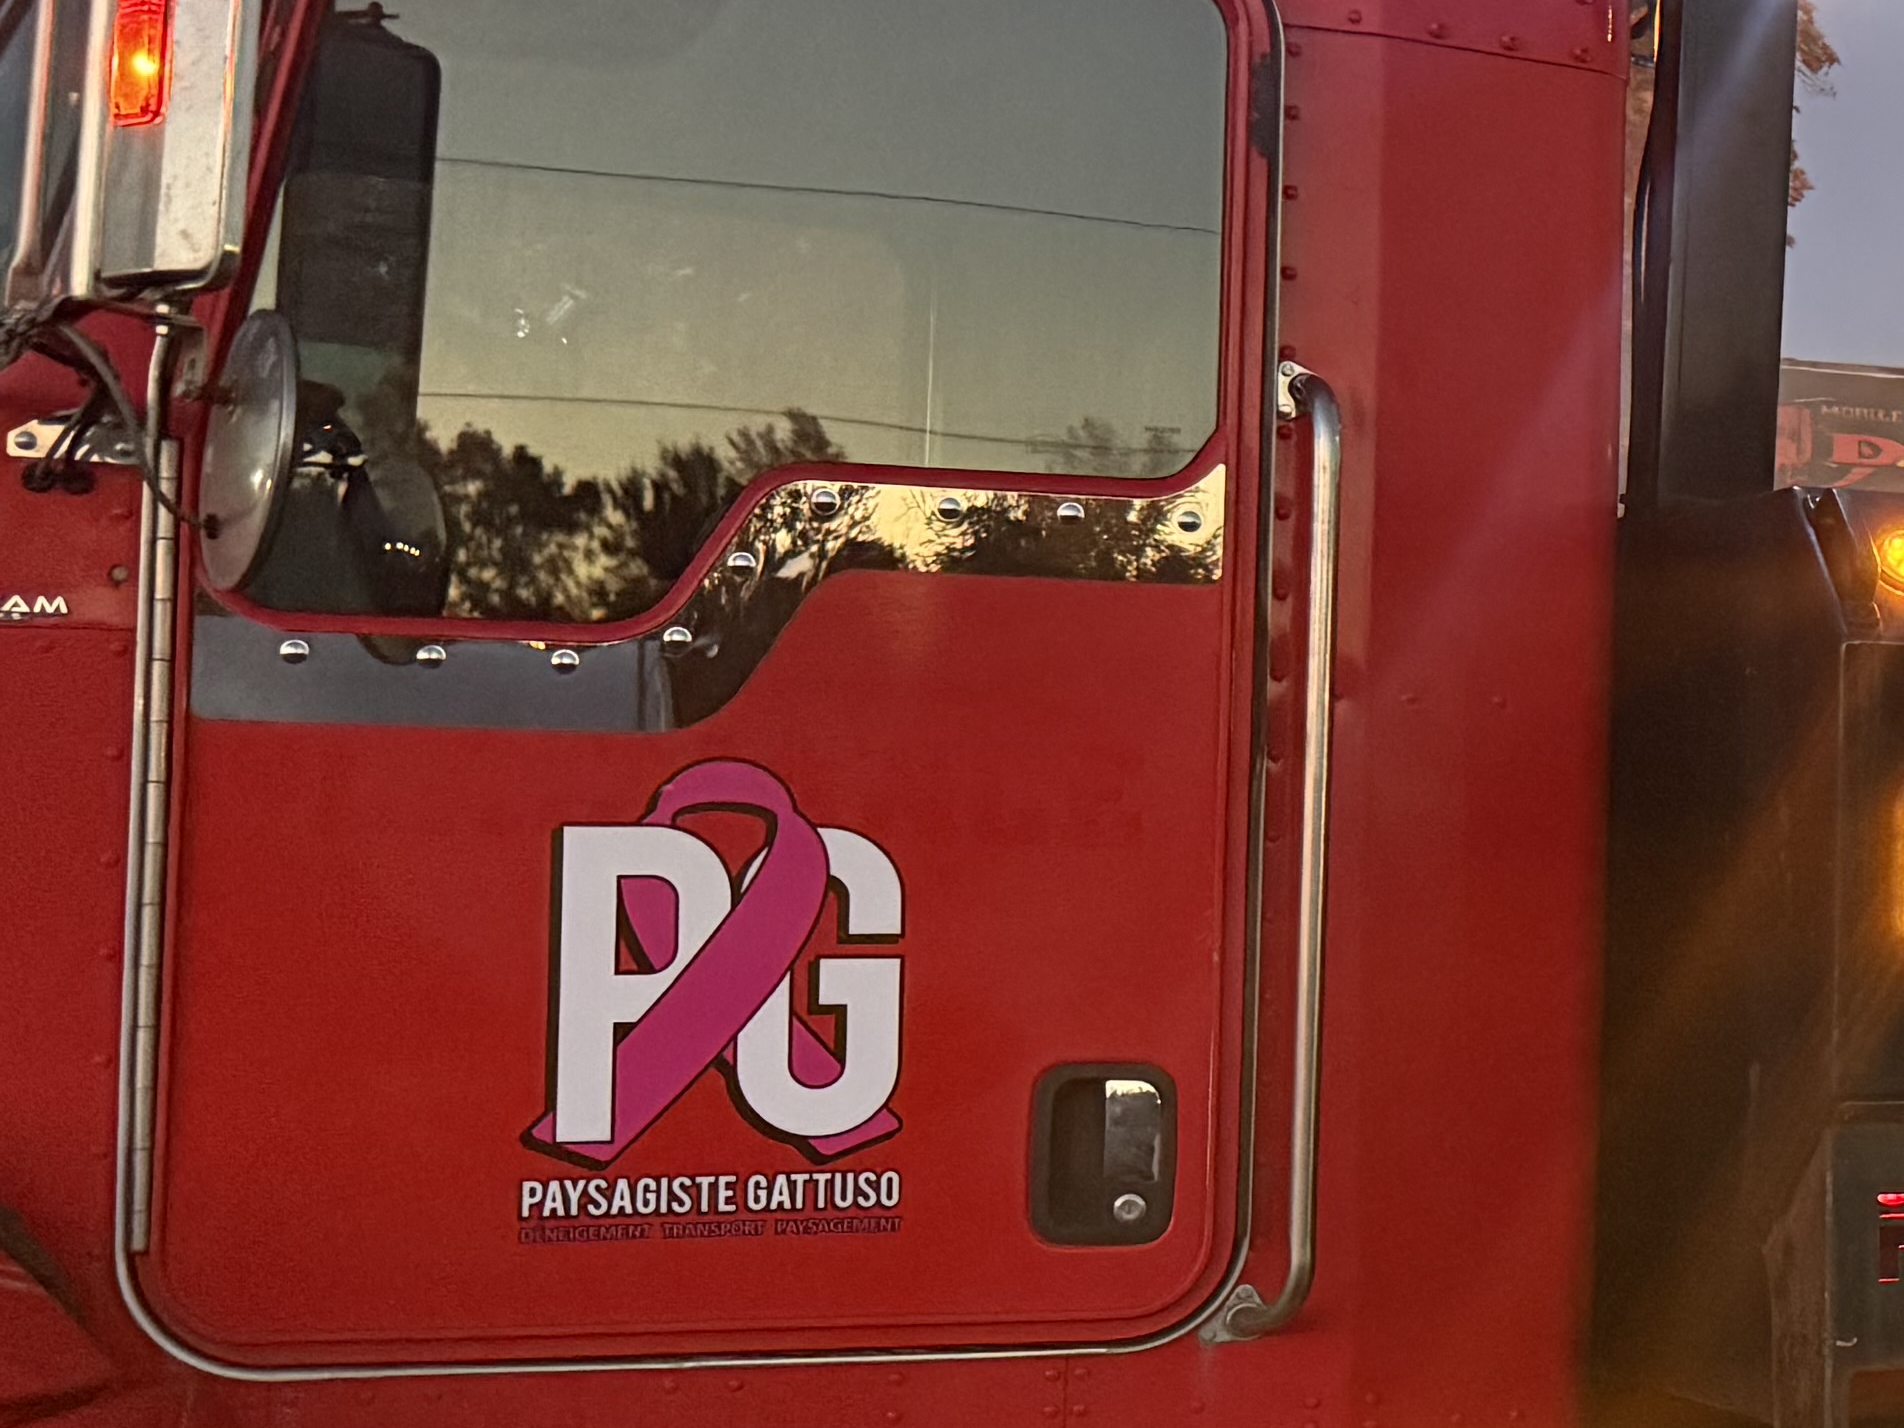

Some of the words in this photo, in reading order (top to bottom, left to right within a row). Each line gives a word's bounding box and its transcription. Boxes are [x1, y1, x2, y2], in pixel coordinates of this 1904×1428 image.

[521, 1176, 737, 1217] PAYSAGISTE
[747, 1171, 901, 1210] GATTUSO
[663, 1222, 764, 1240] TRANSPORT
[776, 1218, 901, 1236] PAYSAGEMENT
